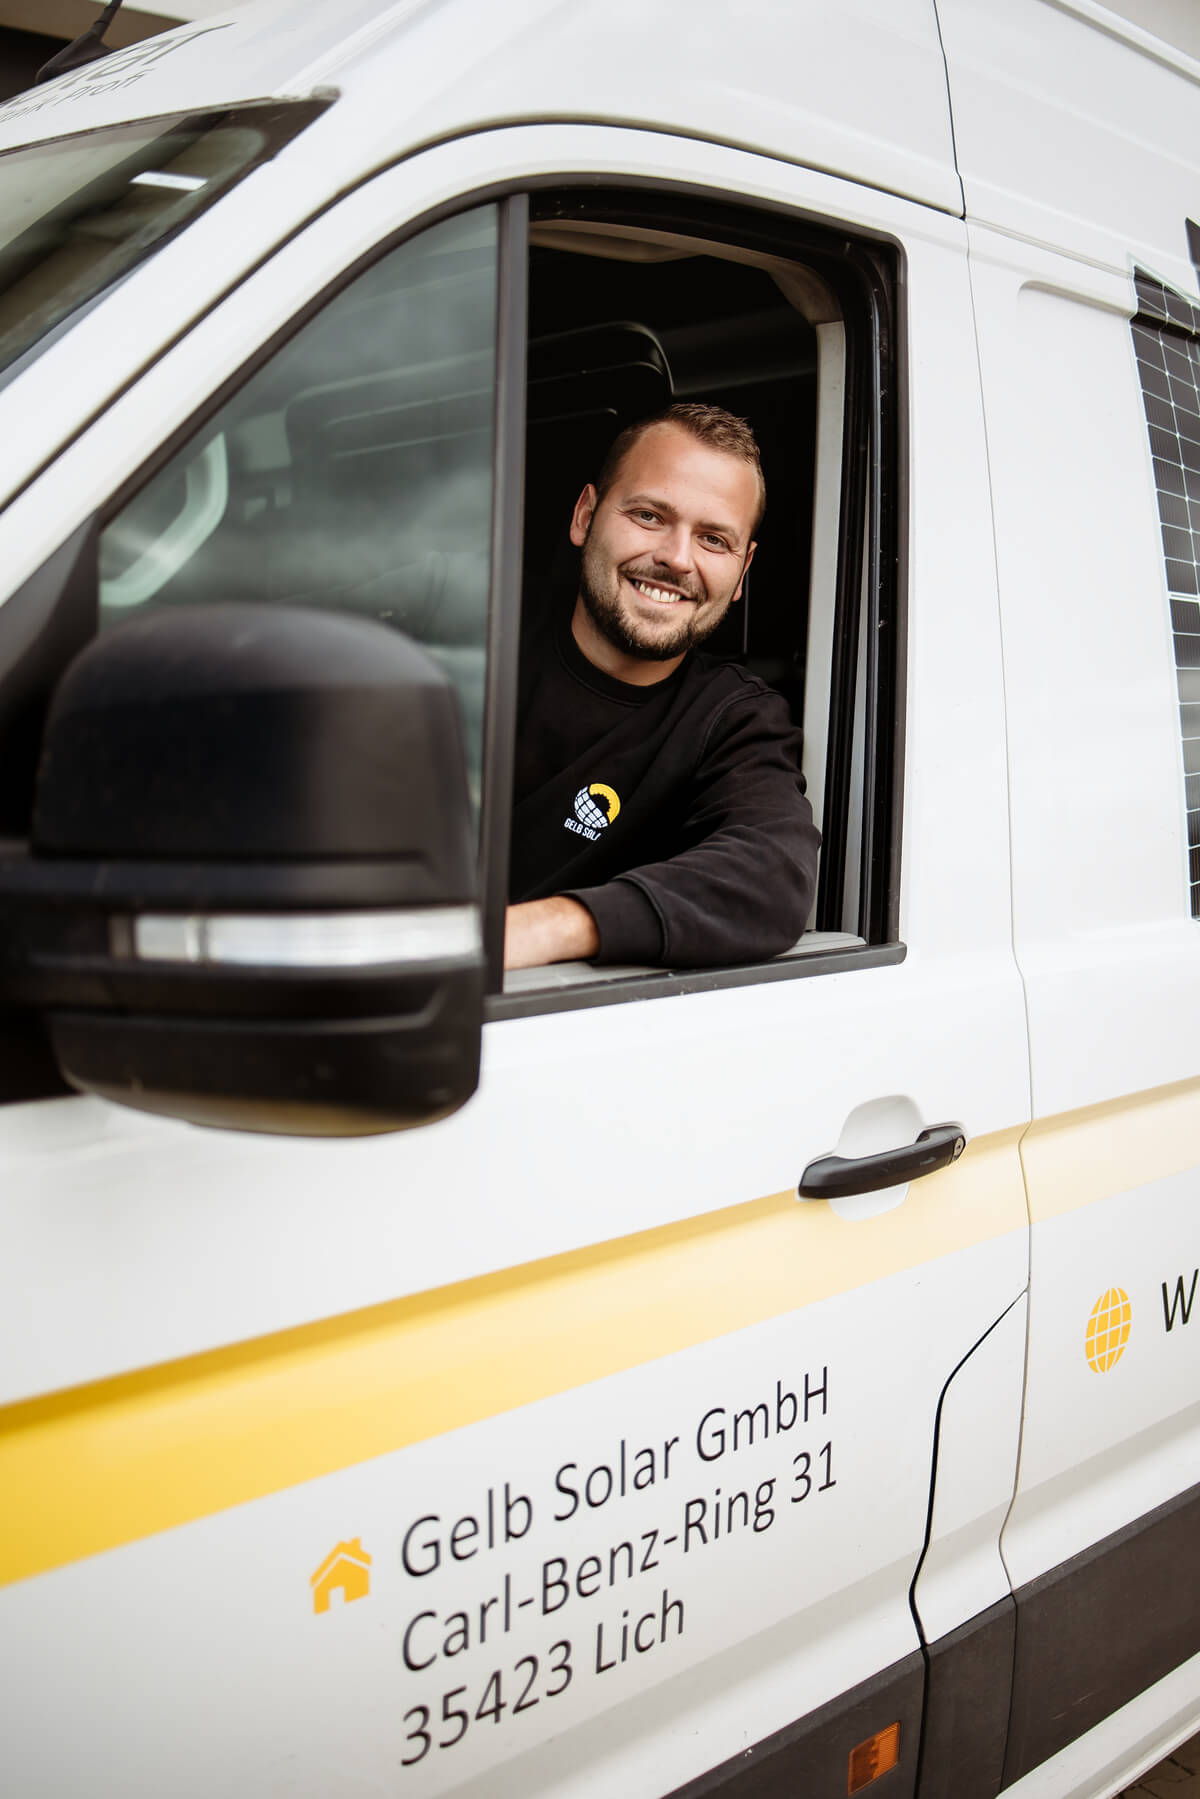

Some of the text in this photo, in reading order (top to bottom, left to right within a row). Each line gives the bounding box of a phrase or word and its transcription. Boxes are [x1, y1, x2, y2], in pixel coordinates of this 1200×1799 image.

[564, 818, 583, 834] GELB
[401, 1366, 828, 1578] Gelb Solar GmbH
[402, 1441, 837, 1672] Carl-Benz-Ring 31
[400, 1589, 684, 1767] 35423 Lich
